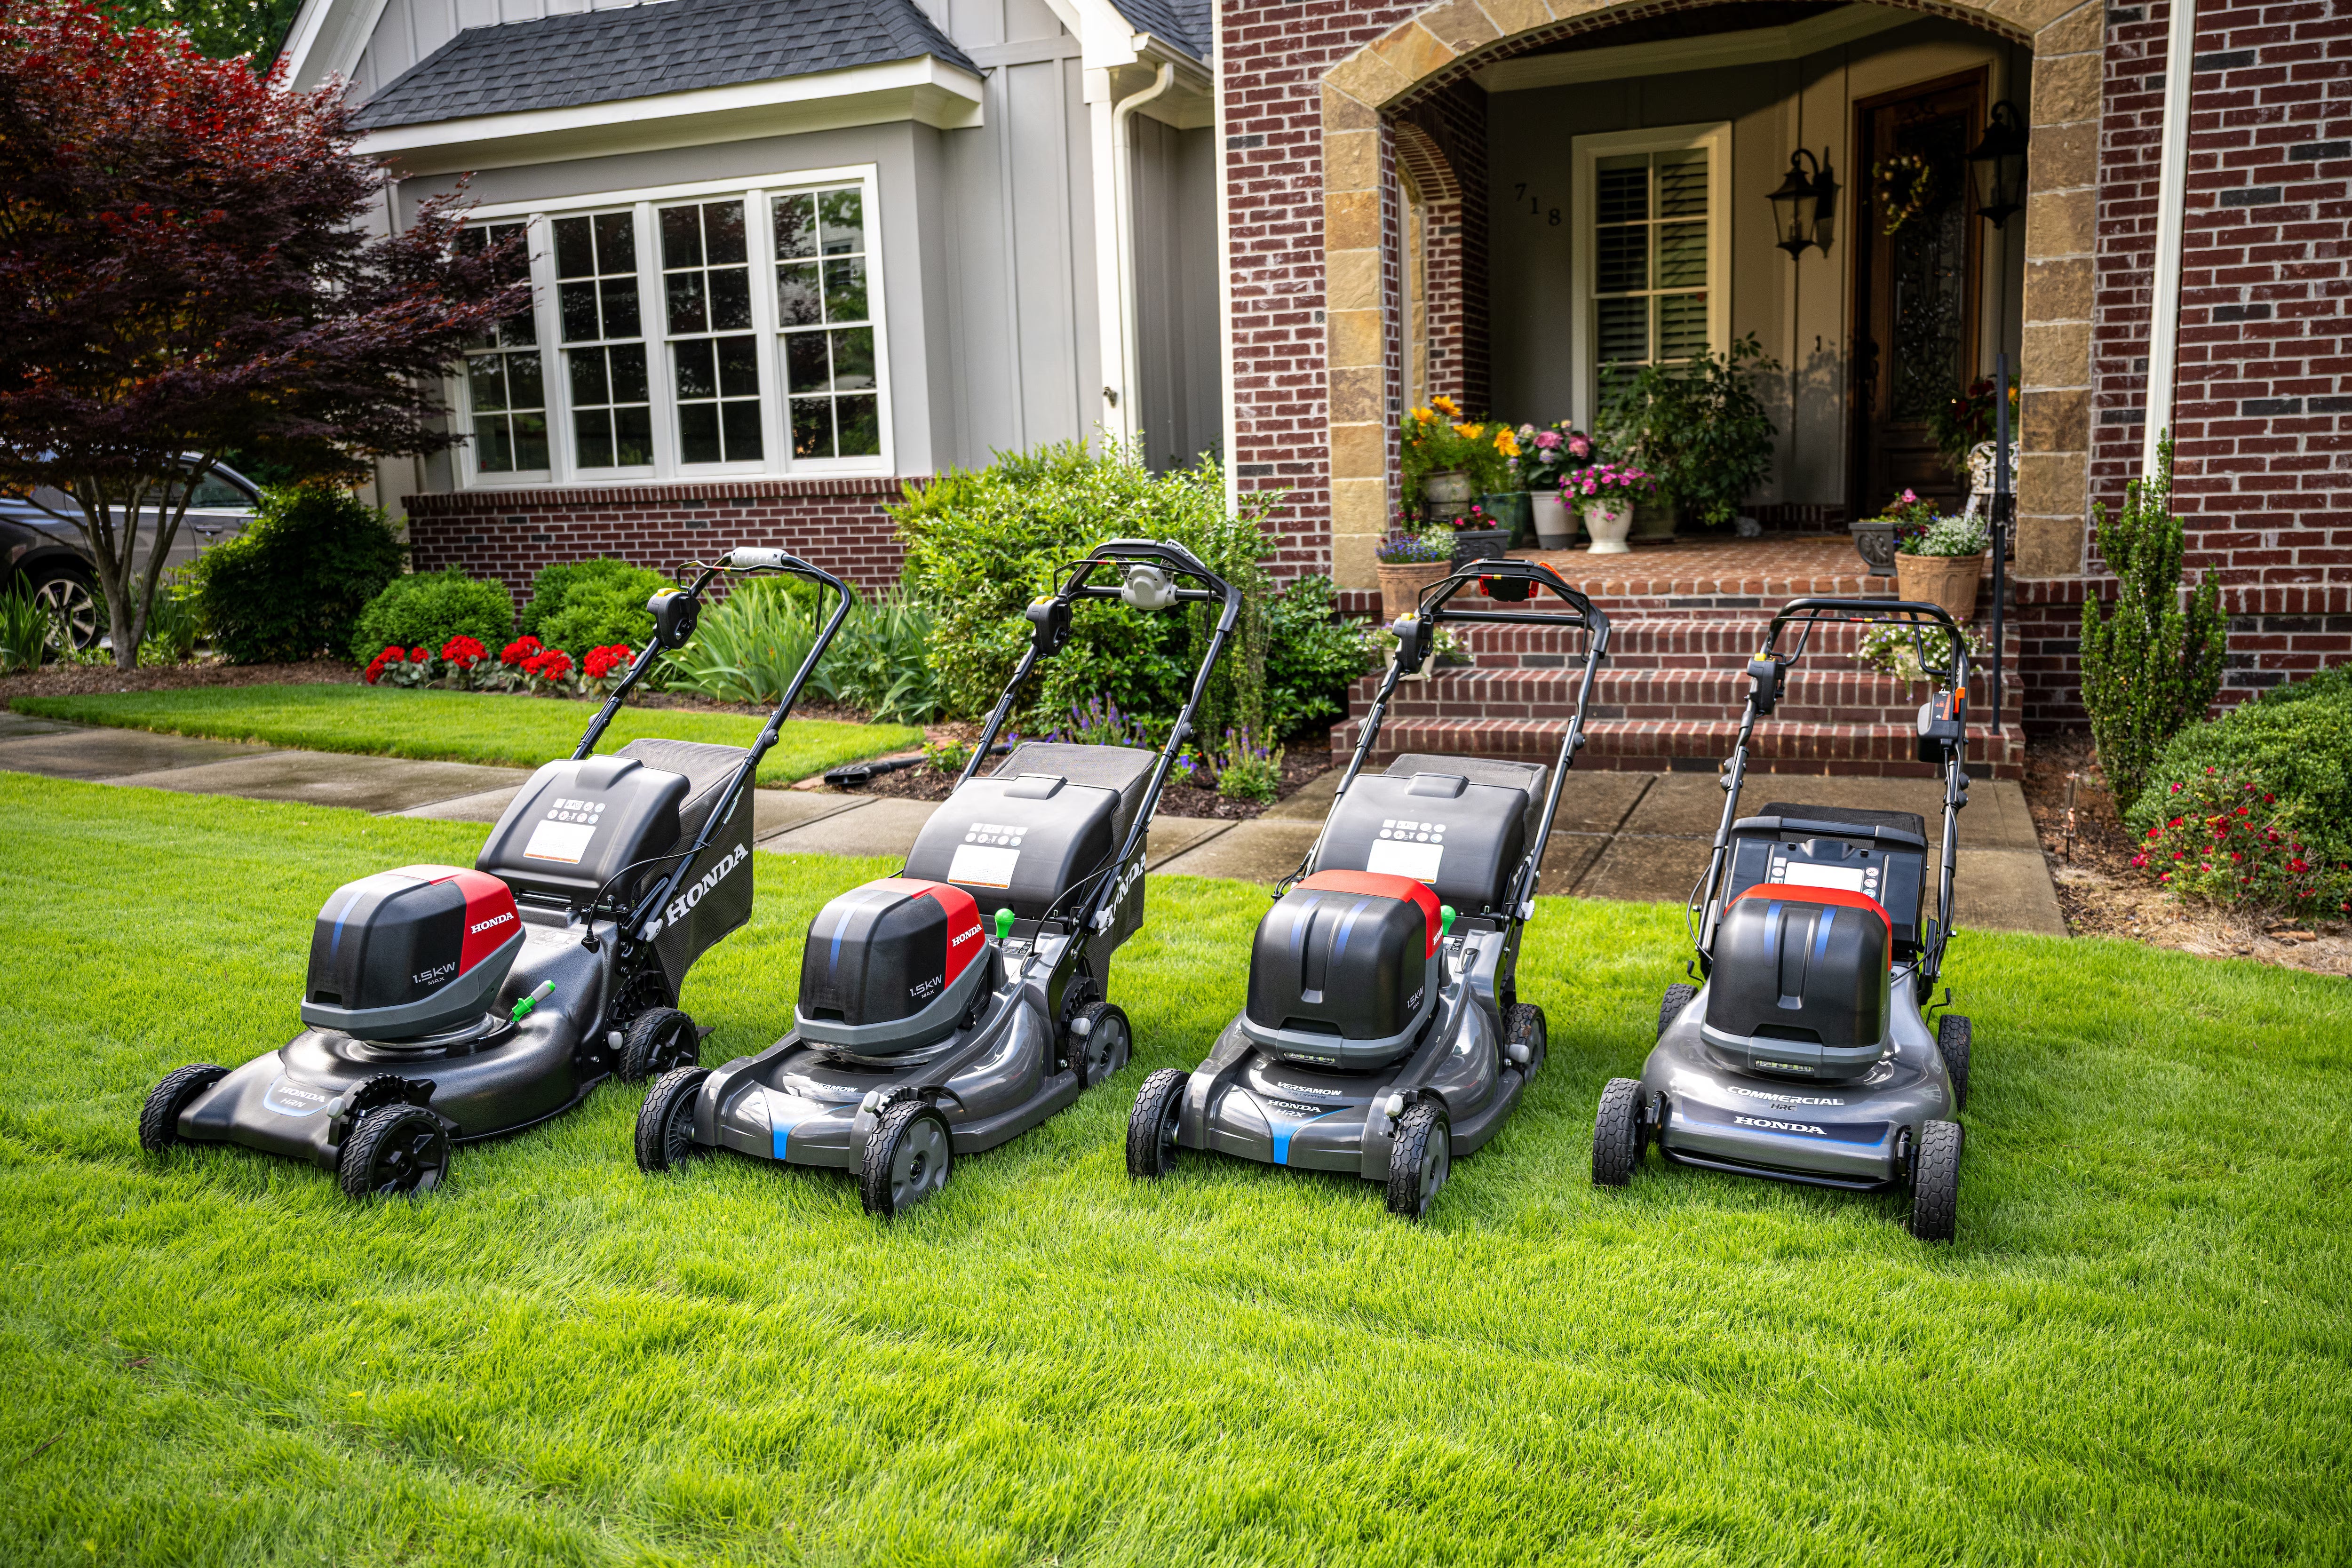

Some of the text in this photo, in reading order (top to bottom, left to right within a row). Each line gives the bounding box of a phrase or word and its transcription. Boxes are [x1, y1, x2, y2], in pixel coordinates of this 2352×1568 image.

[666, 843, 748, 927] HONDA
[471, 912, 514, 934] HONDA
[952, 923, 982, 947] HONDA
[1433, 925, 1443, 946] HOND
[413, 962, 455, 984] 1.5kW
[428, 977, 445, 986] MAX
[909, 974, 942, 997] 1.5kW
[921, 989, 934, 998] MAX
[1407, 985, 1423, 1009] 1.5kW
[278, 1086, 325, 1102] HONDA
[1277, 1082, 1342, 1096] VERSAMOW
[1727, 1086, 1844, 1105] COMMERCIAL
[280, 1098, 306, 1107] HRN
[1267, 1099, 1321, 1113] HONDA
[1275, 1109, 1306, 1117] HRX
[1733, 1116, 1827, 1135] HONDA
